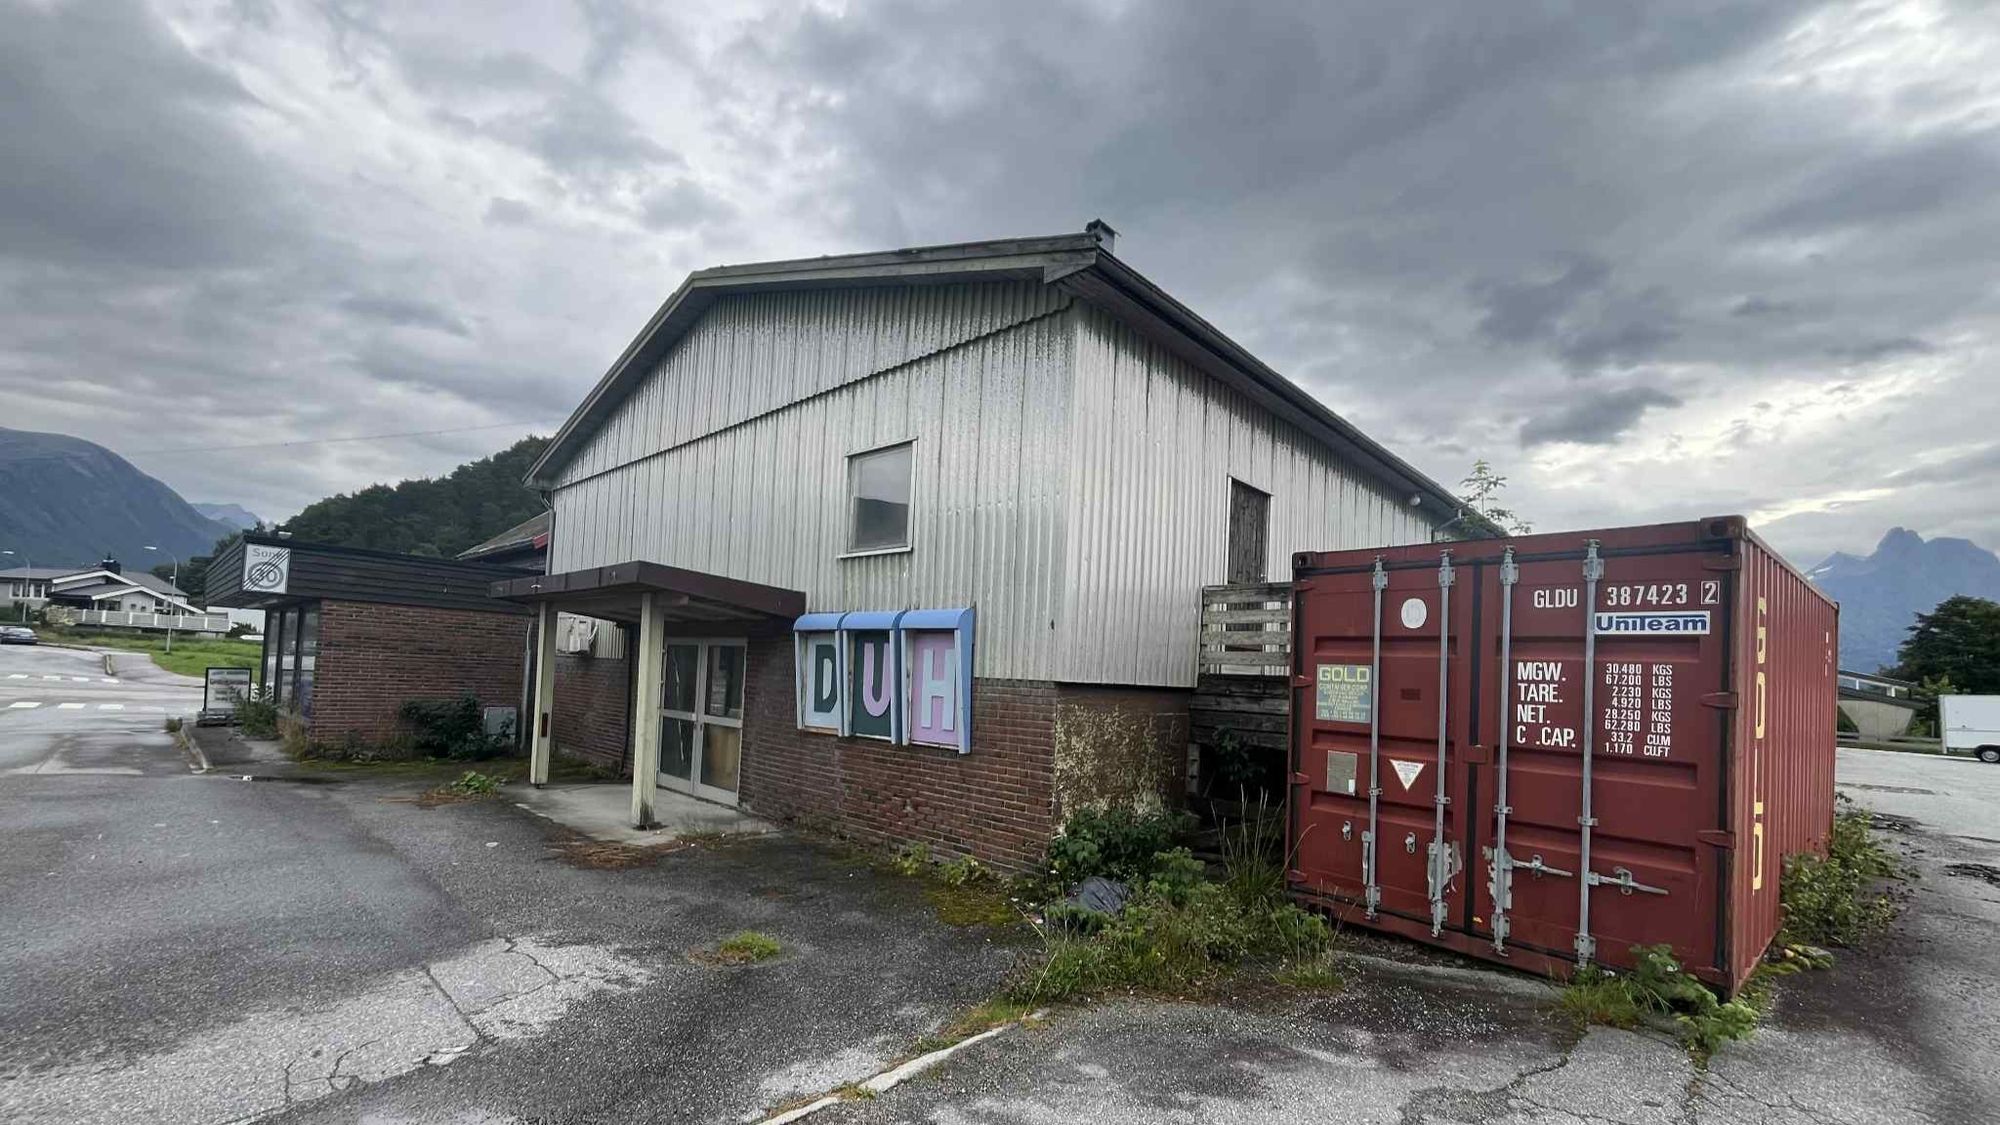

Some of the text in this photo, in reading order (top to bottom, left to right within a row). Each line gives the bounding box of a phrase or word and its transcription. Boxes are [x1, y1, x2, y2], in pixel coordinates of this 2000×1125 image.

[1533, 583, 1716, 608] GLDU 387423 2
[1596, 614, 1707, 631] UniTeam
[1319, 667, 1370, 682] GOLD
[1517, 662, 1566, 682] MGW.
[1606, 663, 1673, 675] 30.480 KGS
[1605, 674, 1672, 687] 67.200 LBS
[1517, 683, 1563, 703] TARE.
[1612, 686, 1672, 699] 2.230 KGS
[1611, 697, 1672, 711] 4.920 LBS
[1517, 704, 1551, 724] NET.
[1605, 708, 1671, 723] 28.250 KGS
[1604, 720, 1671, 734] 62.280 LBS
[1610, 731, 1633, 743] 33.2
[1604, 742, 1633, 754] 1.170
